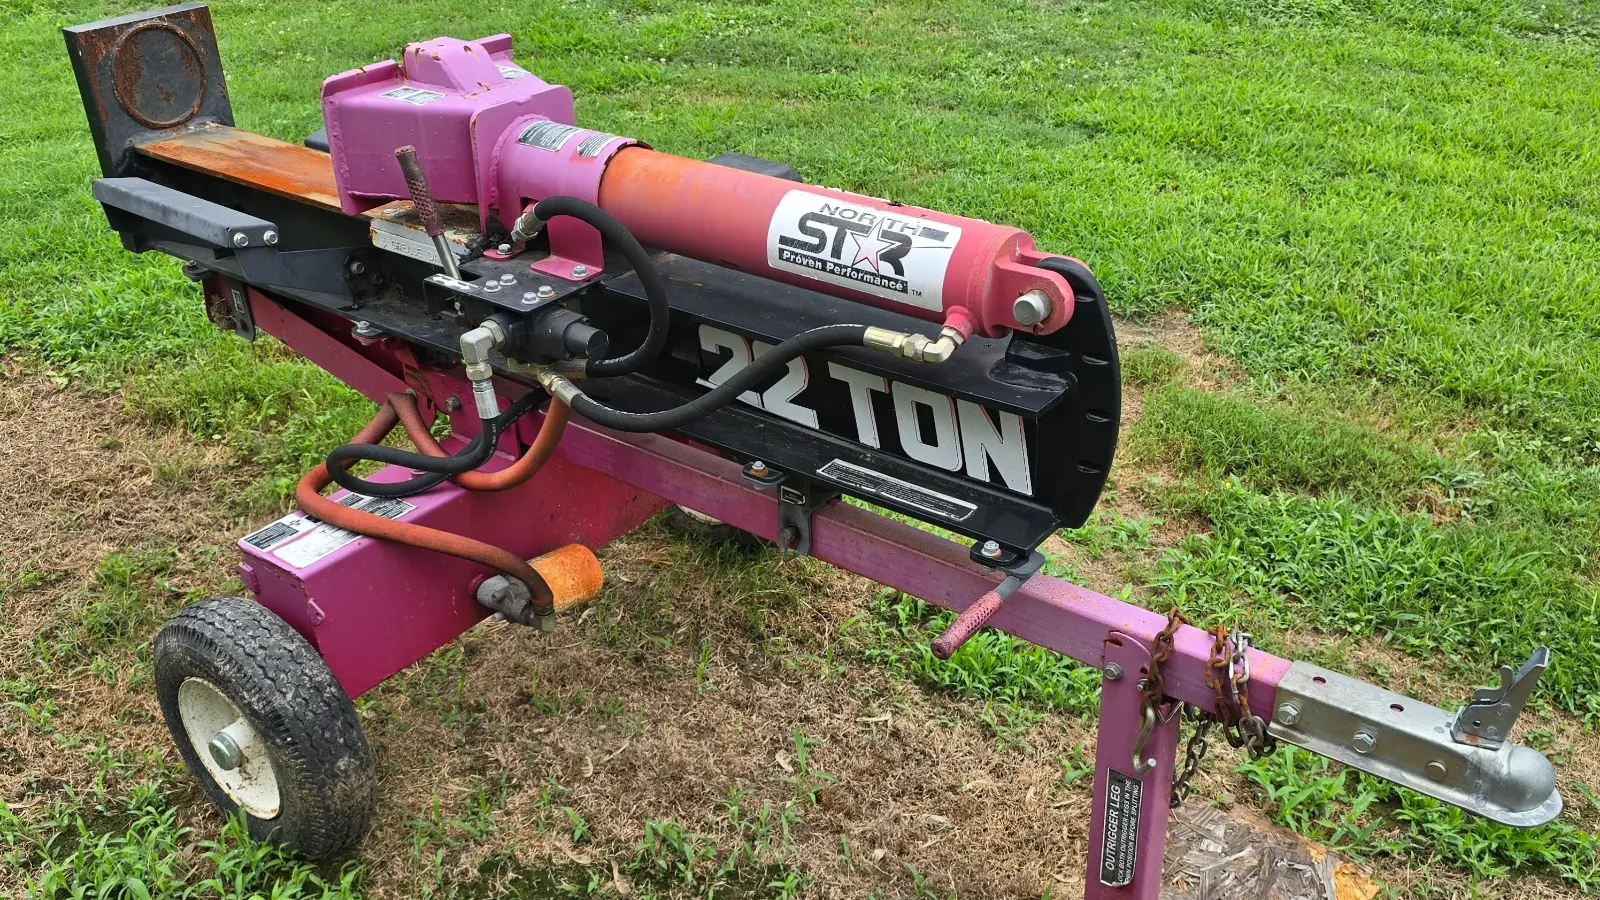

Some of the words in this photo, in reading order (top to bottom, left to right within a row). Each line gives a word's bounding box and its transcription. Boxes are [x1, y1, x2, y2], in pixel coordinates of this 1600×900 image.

[819, 203, 922, 236] NORTH
[782, 250, 822, 270] Proven
[826, 262, 906, 292] Performance
[911, 289, 923, 298] TM
[696, 323, 820, 430] 22
[827, 361, 1033, 497] TON
[1110, 784, 1121, 808] LEG
[1120, 817, 1128, 852] OUTRIGGER
[1124, 790, 1131, 799] IN
[1105, 808, 1119, 870] OUTRIGGER
[1126, 840, 1134, 873] POSITION
[1130, 784, 1139, 816] SPLITTING
